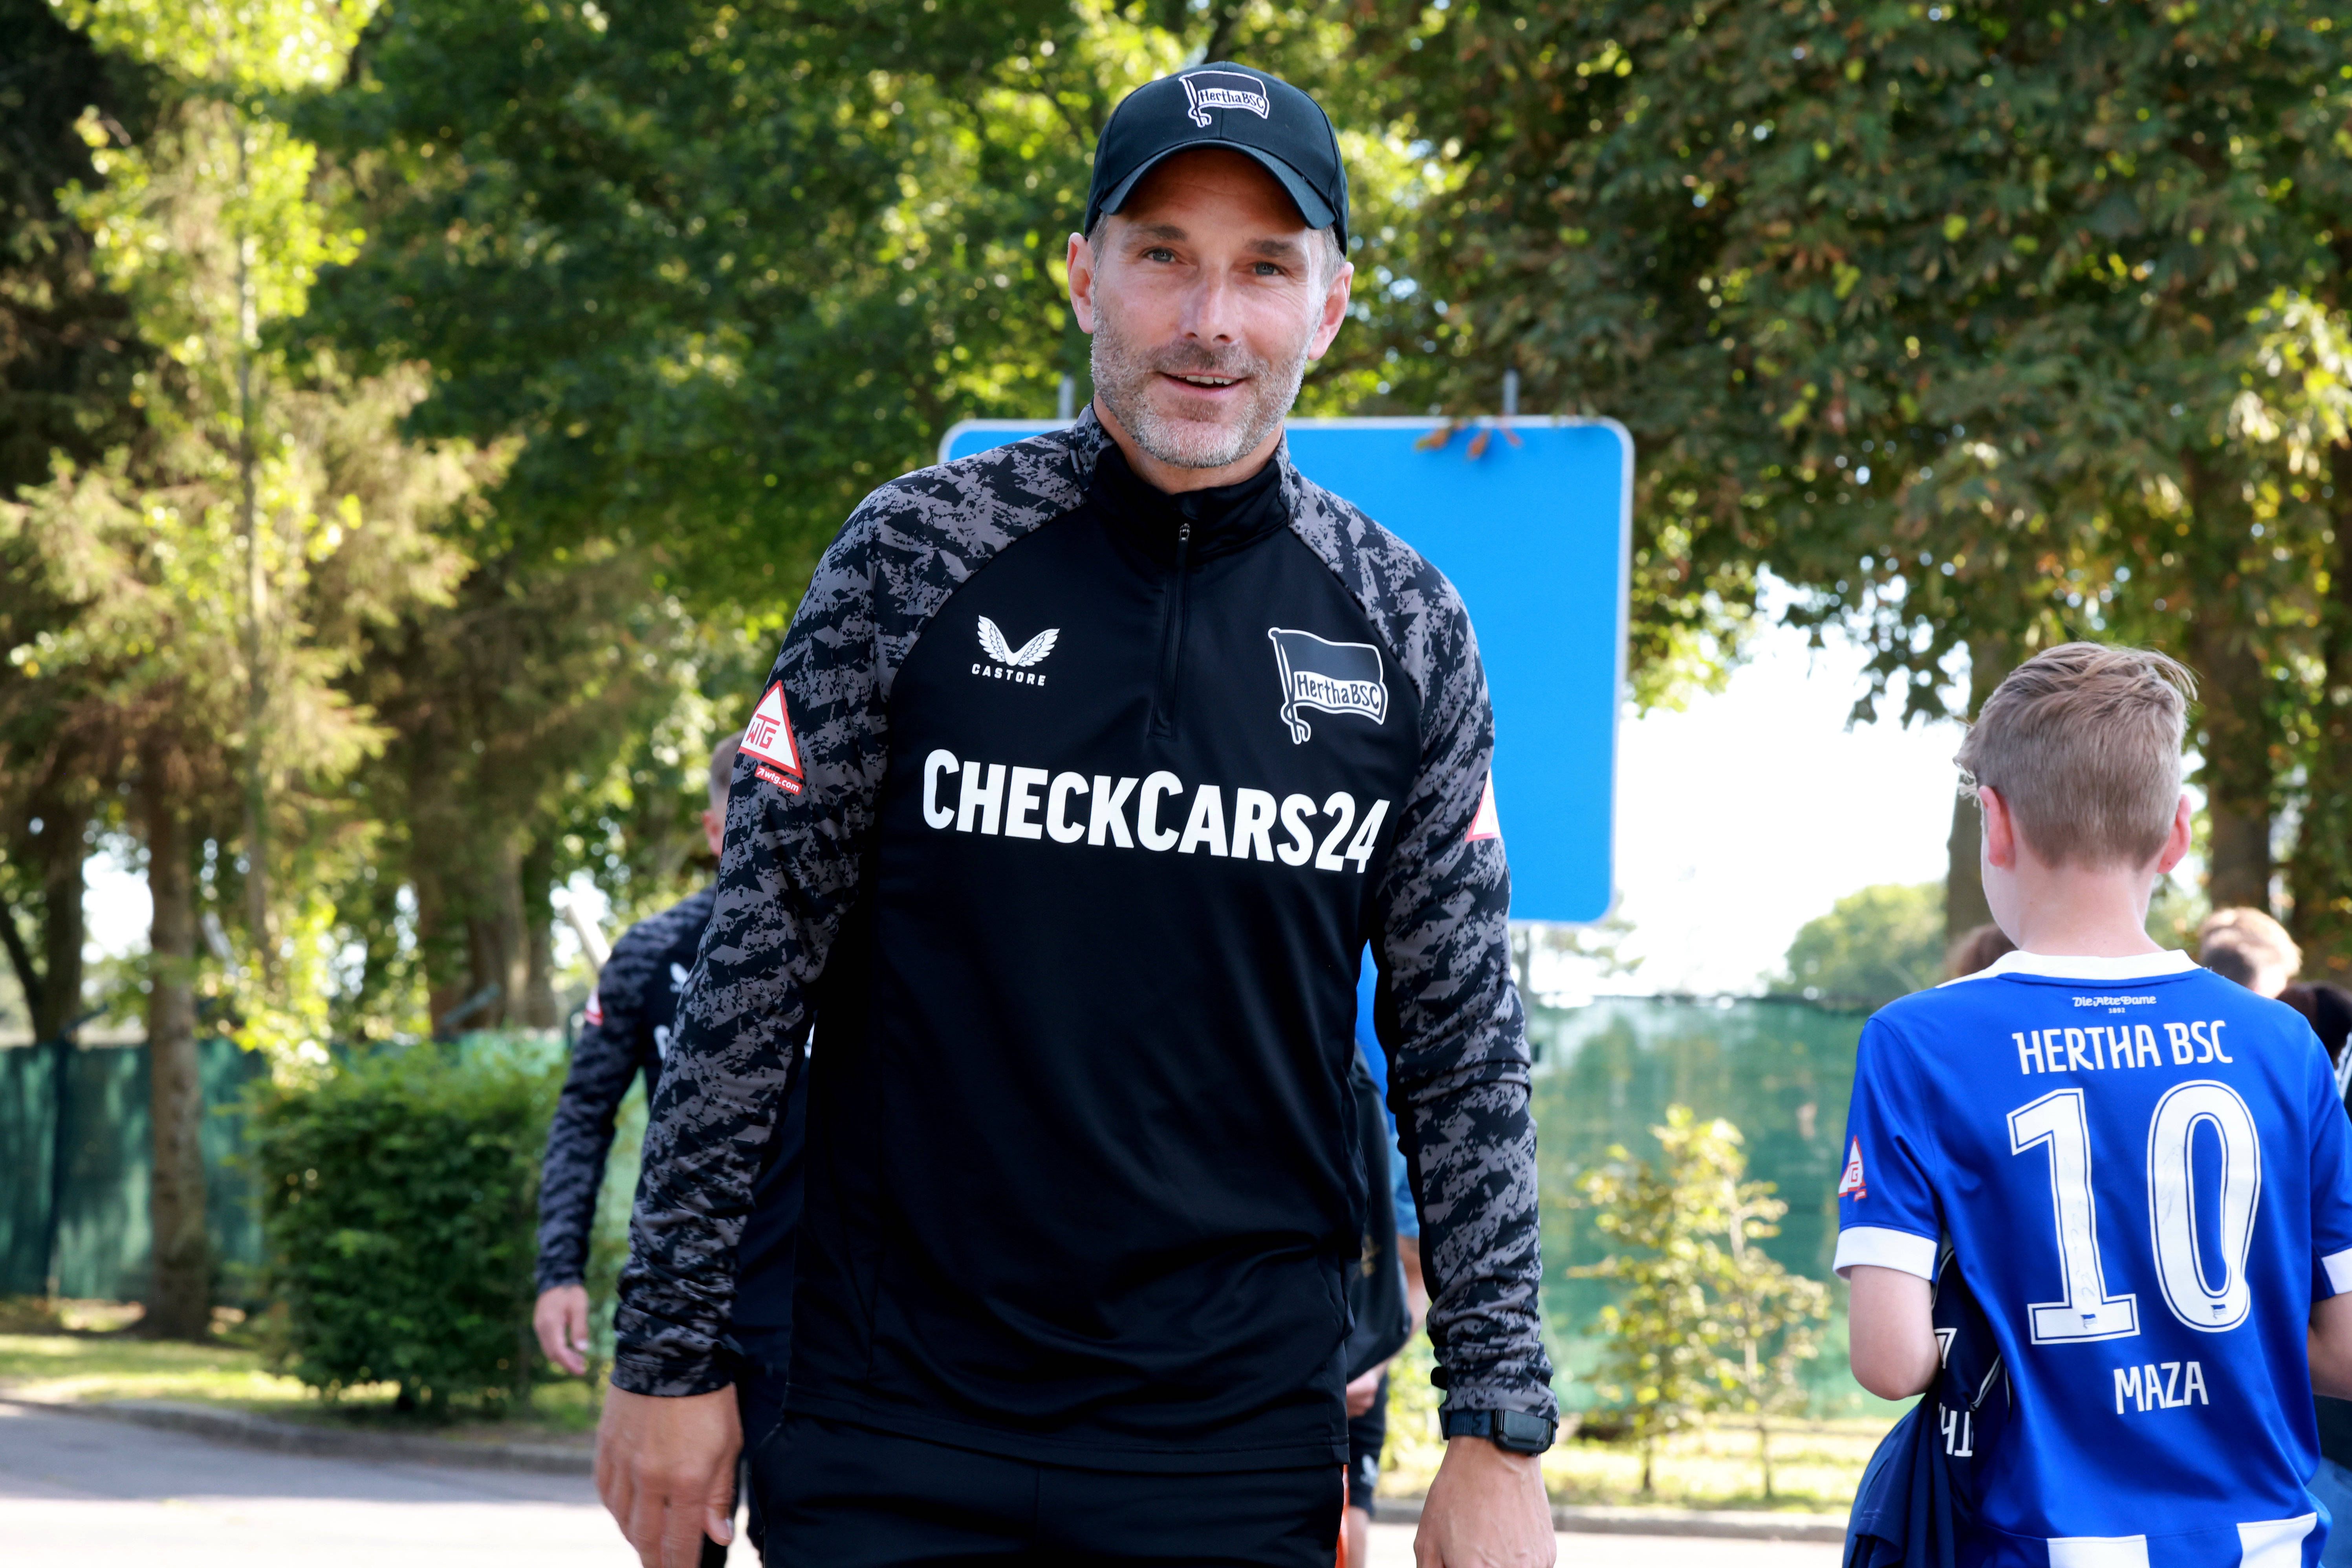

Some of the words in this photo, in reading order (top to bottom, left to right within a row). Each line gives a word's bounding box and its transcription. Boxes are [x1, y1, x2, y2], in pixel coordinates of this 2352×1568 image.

[971, 663, 1046, 686] CASTORE
[746, 713, 781, 749] WTG
[2011, 1024, 2162, 1075] HERTHA
[2163, 1020, 2233, 1065] BSC
[2006, 1079, 2261, 1345] 10
[2113, 1361, 2209, 1414] MAZA
